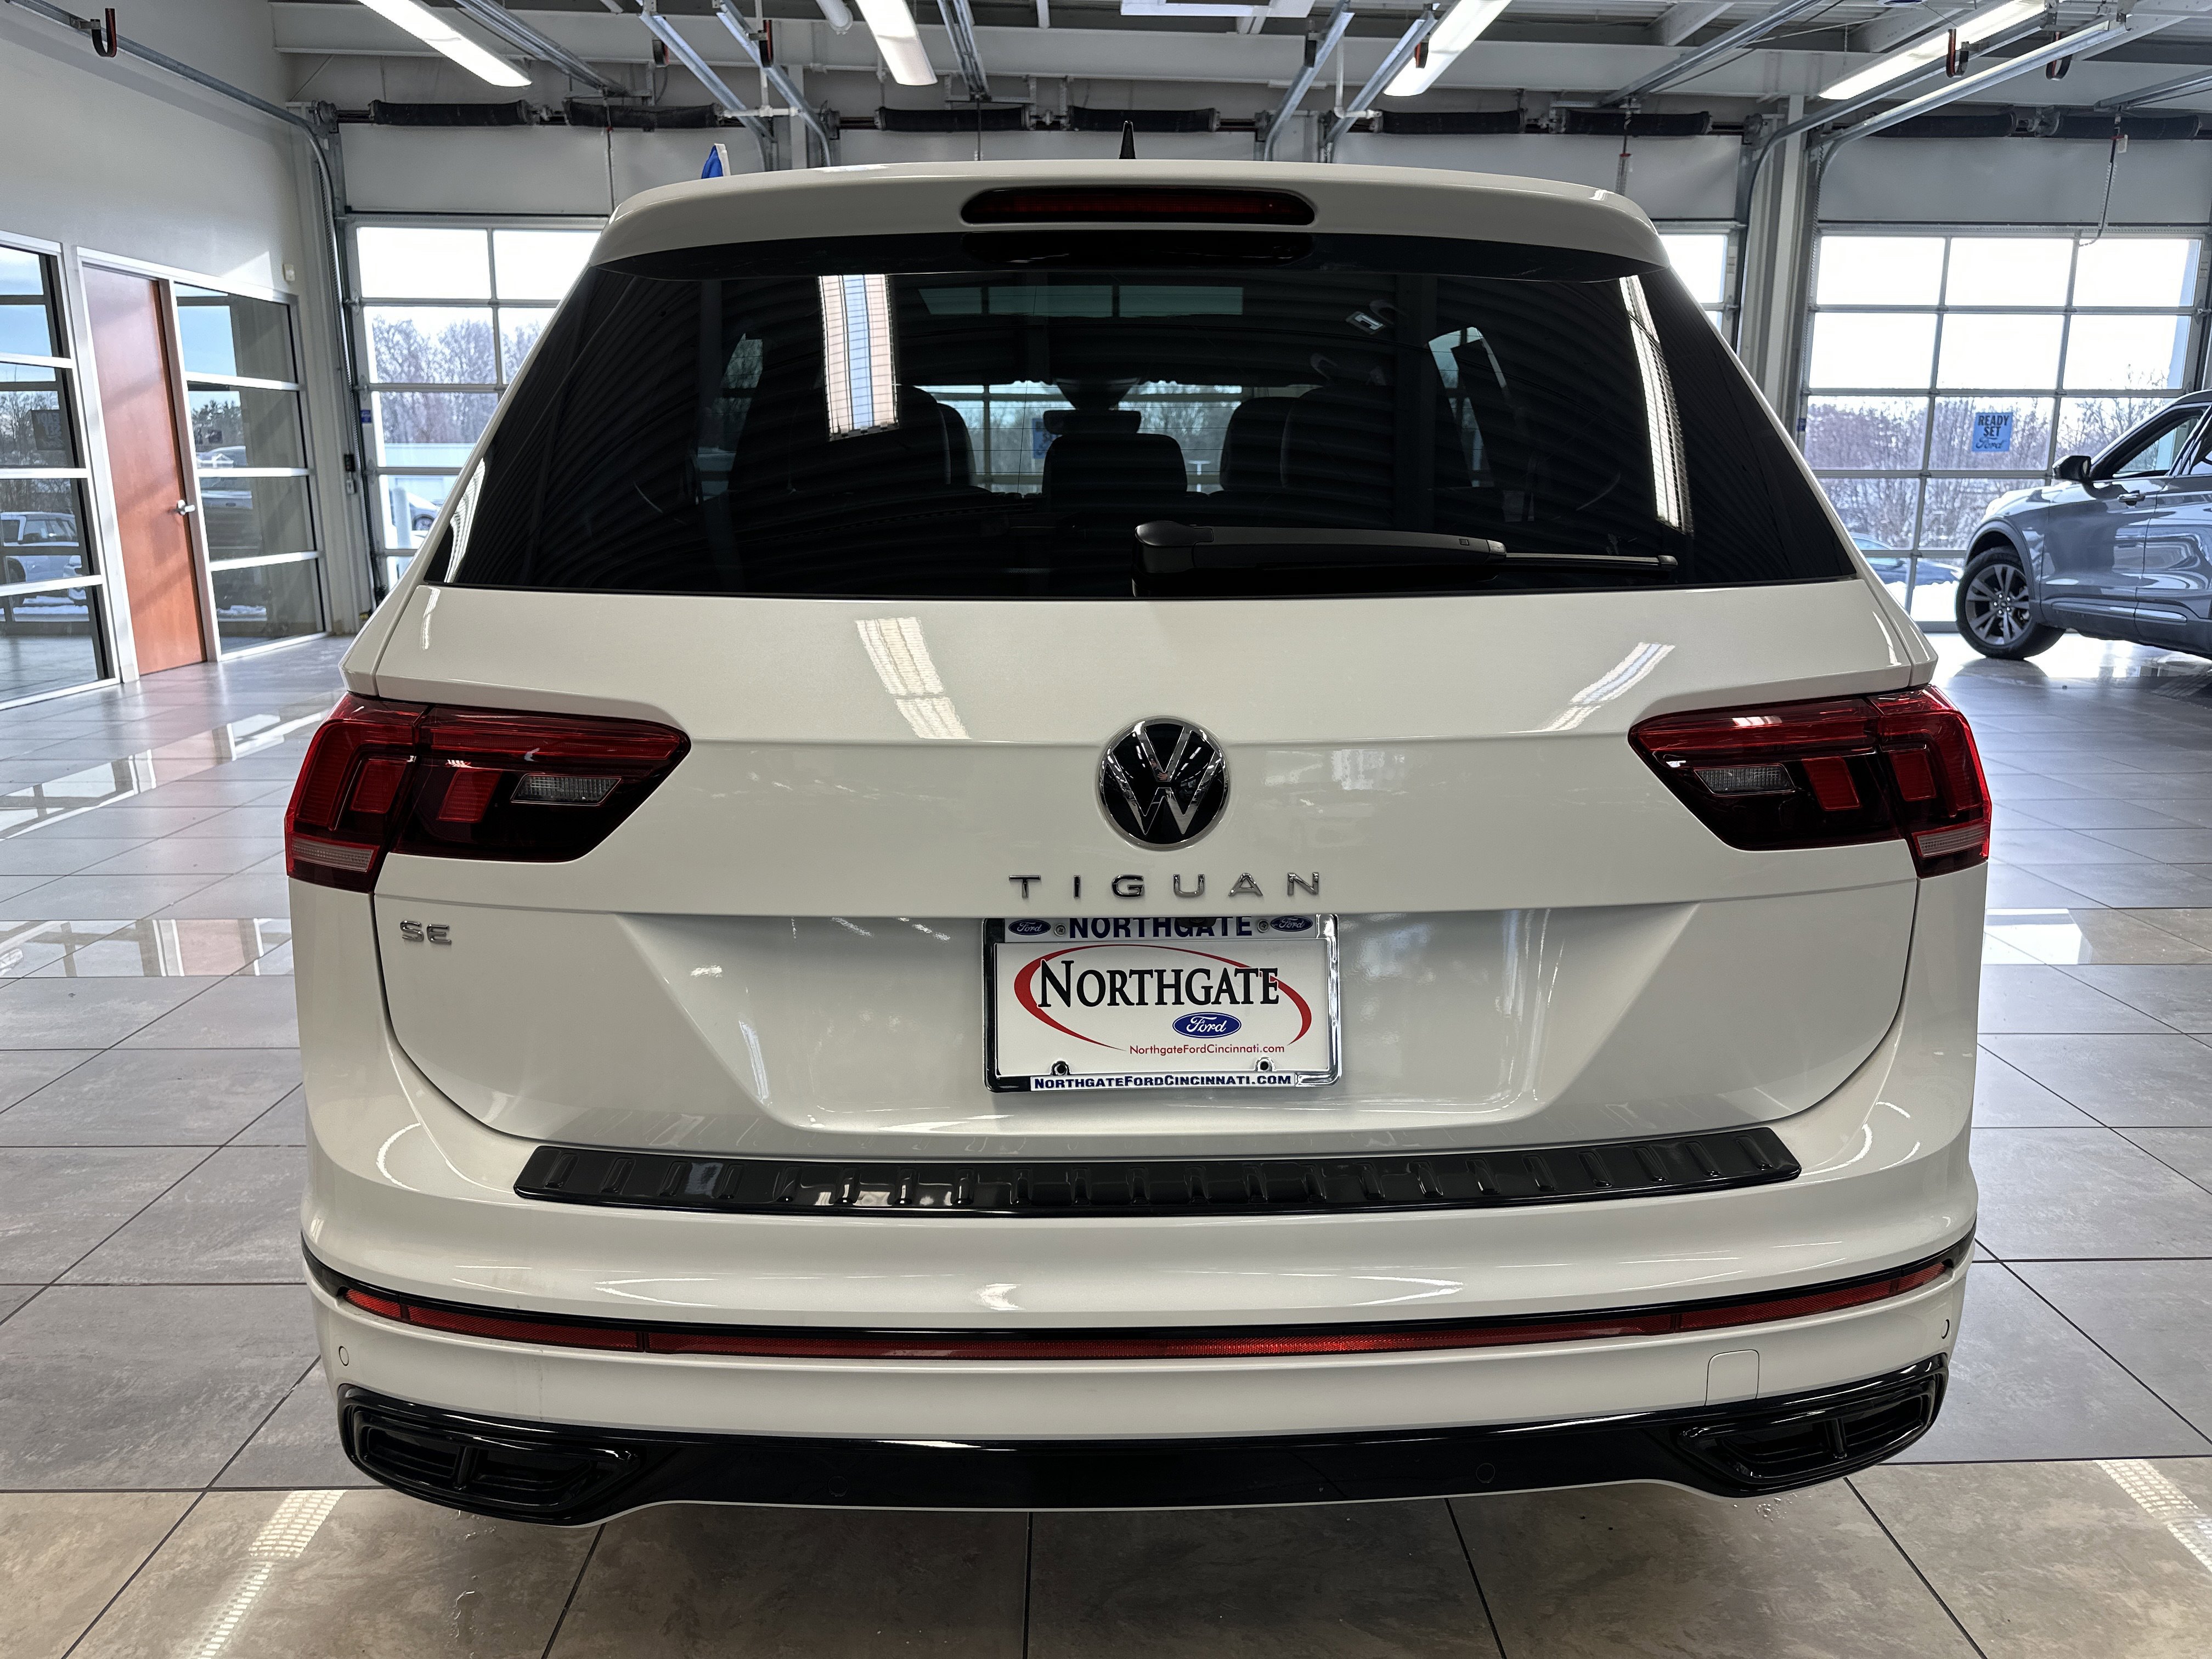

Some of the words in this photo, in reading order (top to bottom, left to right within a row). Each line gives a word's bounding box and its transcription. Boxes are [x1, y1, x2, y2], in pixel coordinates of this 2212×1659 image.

[1978, 415, 2010, 426] READY
[1983, 426, 2001, 437] SET
[1976, 437, 2006, 449] Ford
[1009, 872, 1319, 899] TIGUAN
[1017, 921, 1042, 933] Ford
[1278, 918, 1305, 929] Ford
[400, 920, 452, 945] SE
[1186, 1015, 1227, 1032] Ford
[1129, 1043, 1285, 1056] NorthgateFordCincinnati.com
